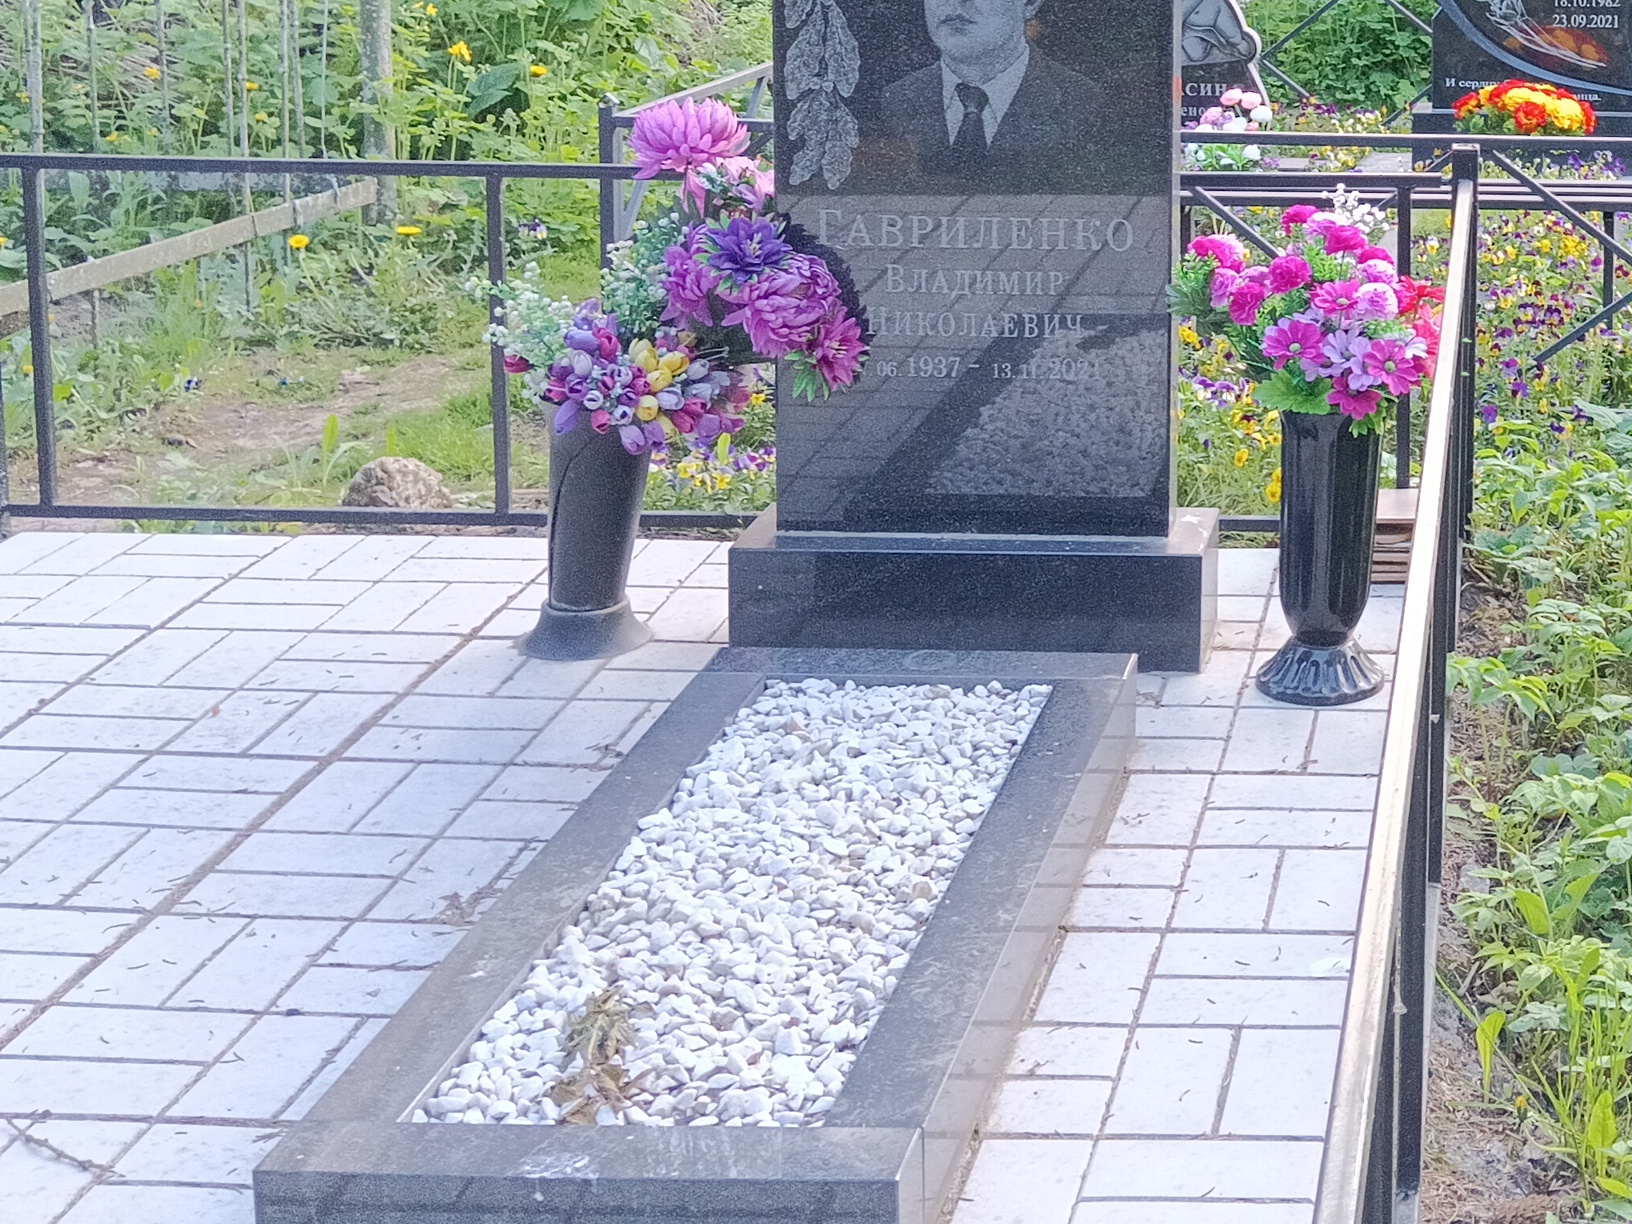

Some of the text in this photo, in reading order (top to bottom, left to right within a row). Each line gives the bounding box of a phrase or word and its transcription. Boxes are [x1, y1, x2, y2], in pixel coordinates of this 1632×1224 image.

[1552, 14, 1620, 29] 23.09.2021
[1445, 77, 1456, 87] И
[816, 208, 1135, 253] ГАВРИЛЕНКО
[884, 263, 1066, 296] ВЛАДИМИР
[864, 305, 1085, 339] НИКОЛАЕВИЧ
